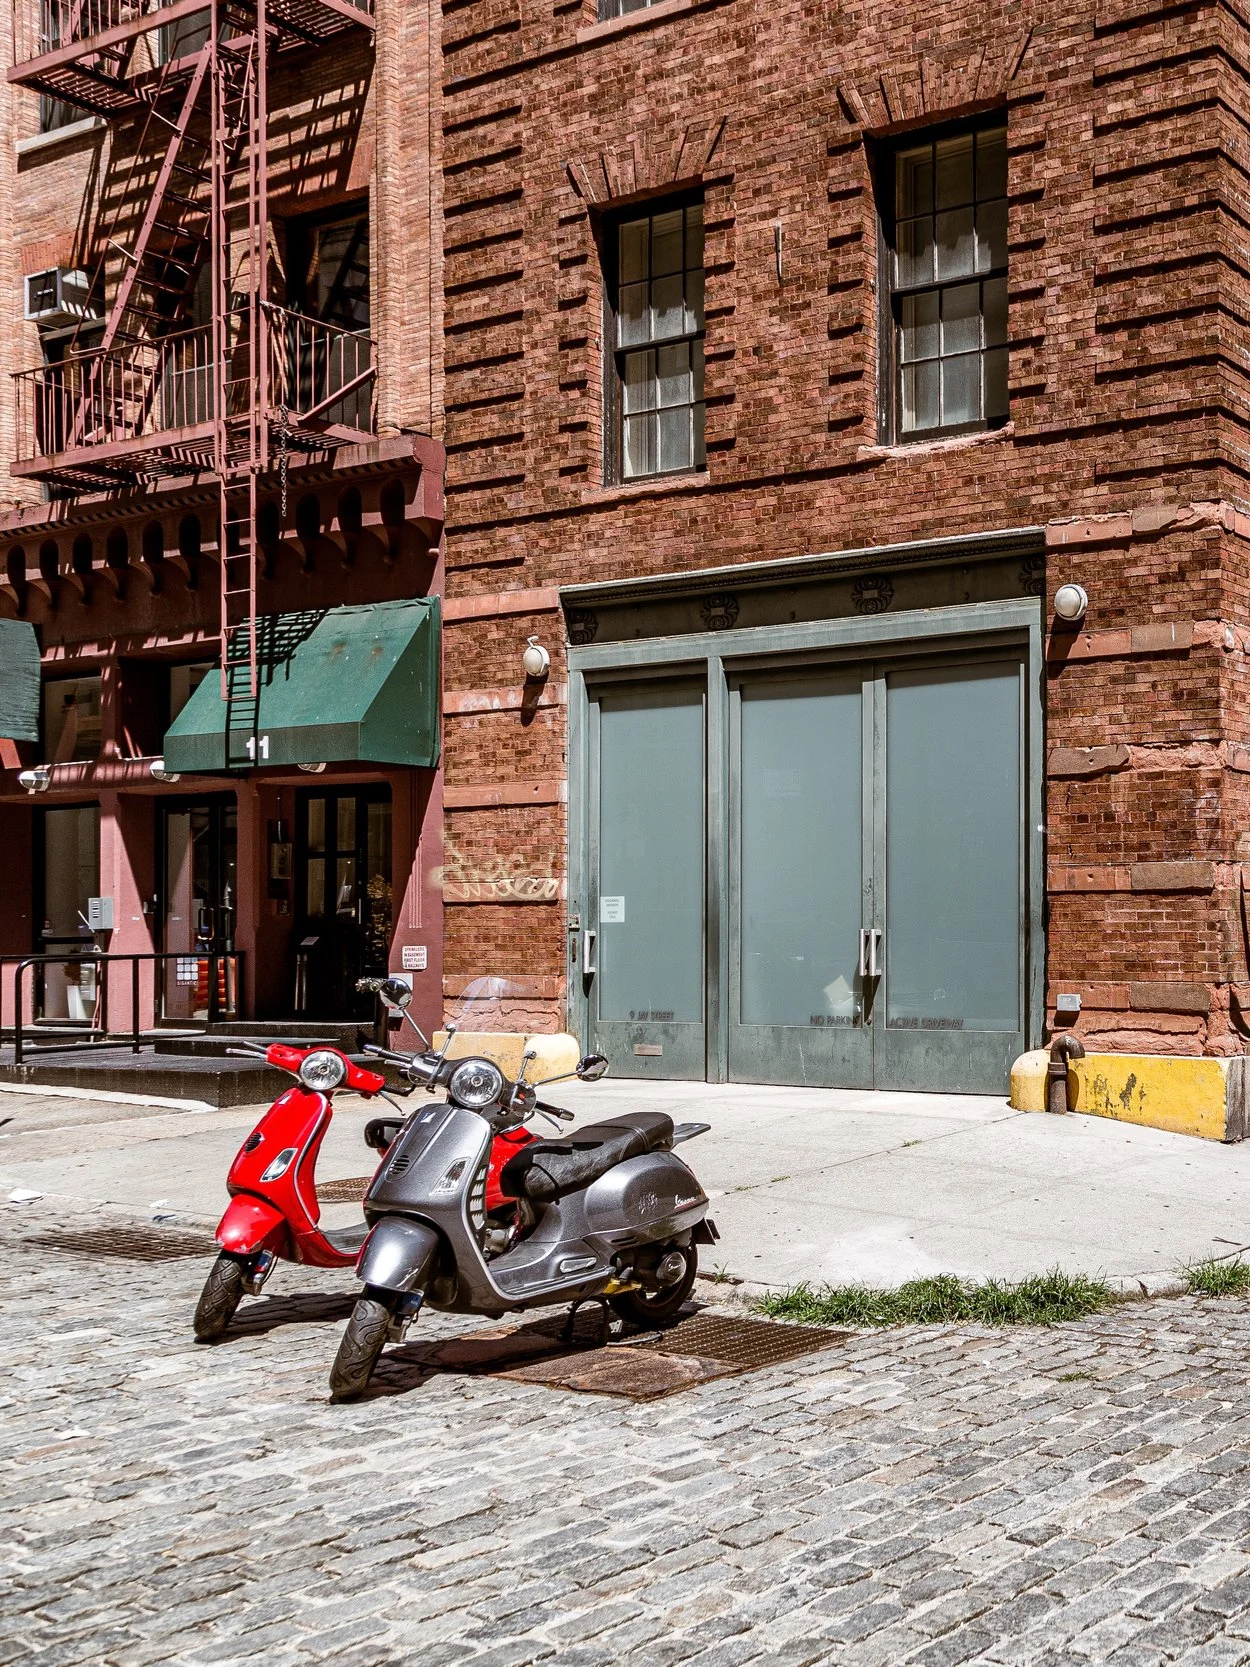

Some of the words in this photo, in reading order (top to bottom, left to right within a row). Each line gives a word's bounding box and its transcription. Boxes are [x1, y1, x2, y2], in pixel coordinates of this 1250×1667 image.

[246, 735, 269, 760] 11
[630, 1010, 635, 1020] 9
[651, 1010, 674, 1021] STREET
[810, 1015, 824, 1026] NO
[827, 1015, 861, 1027] PARKING
[889, 1017, 918, 1029] ACTIVE
[921, 1018, 963, 1030] DRIVEWAY
